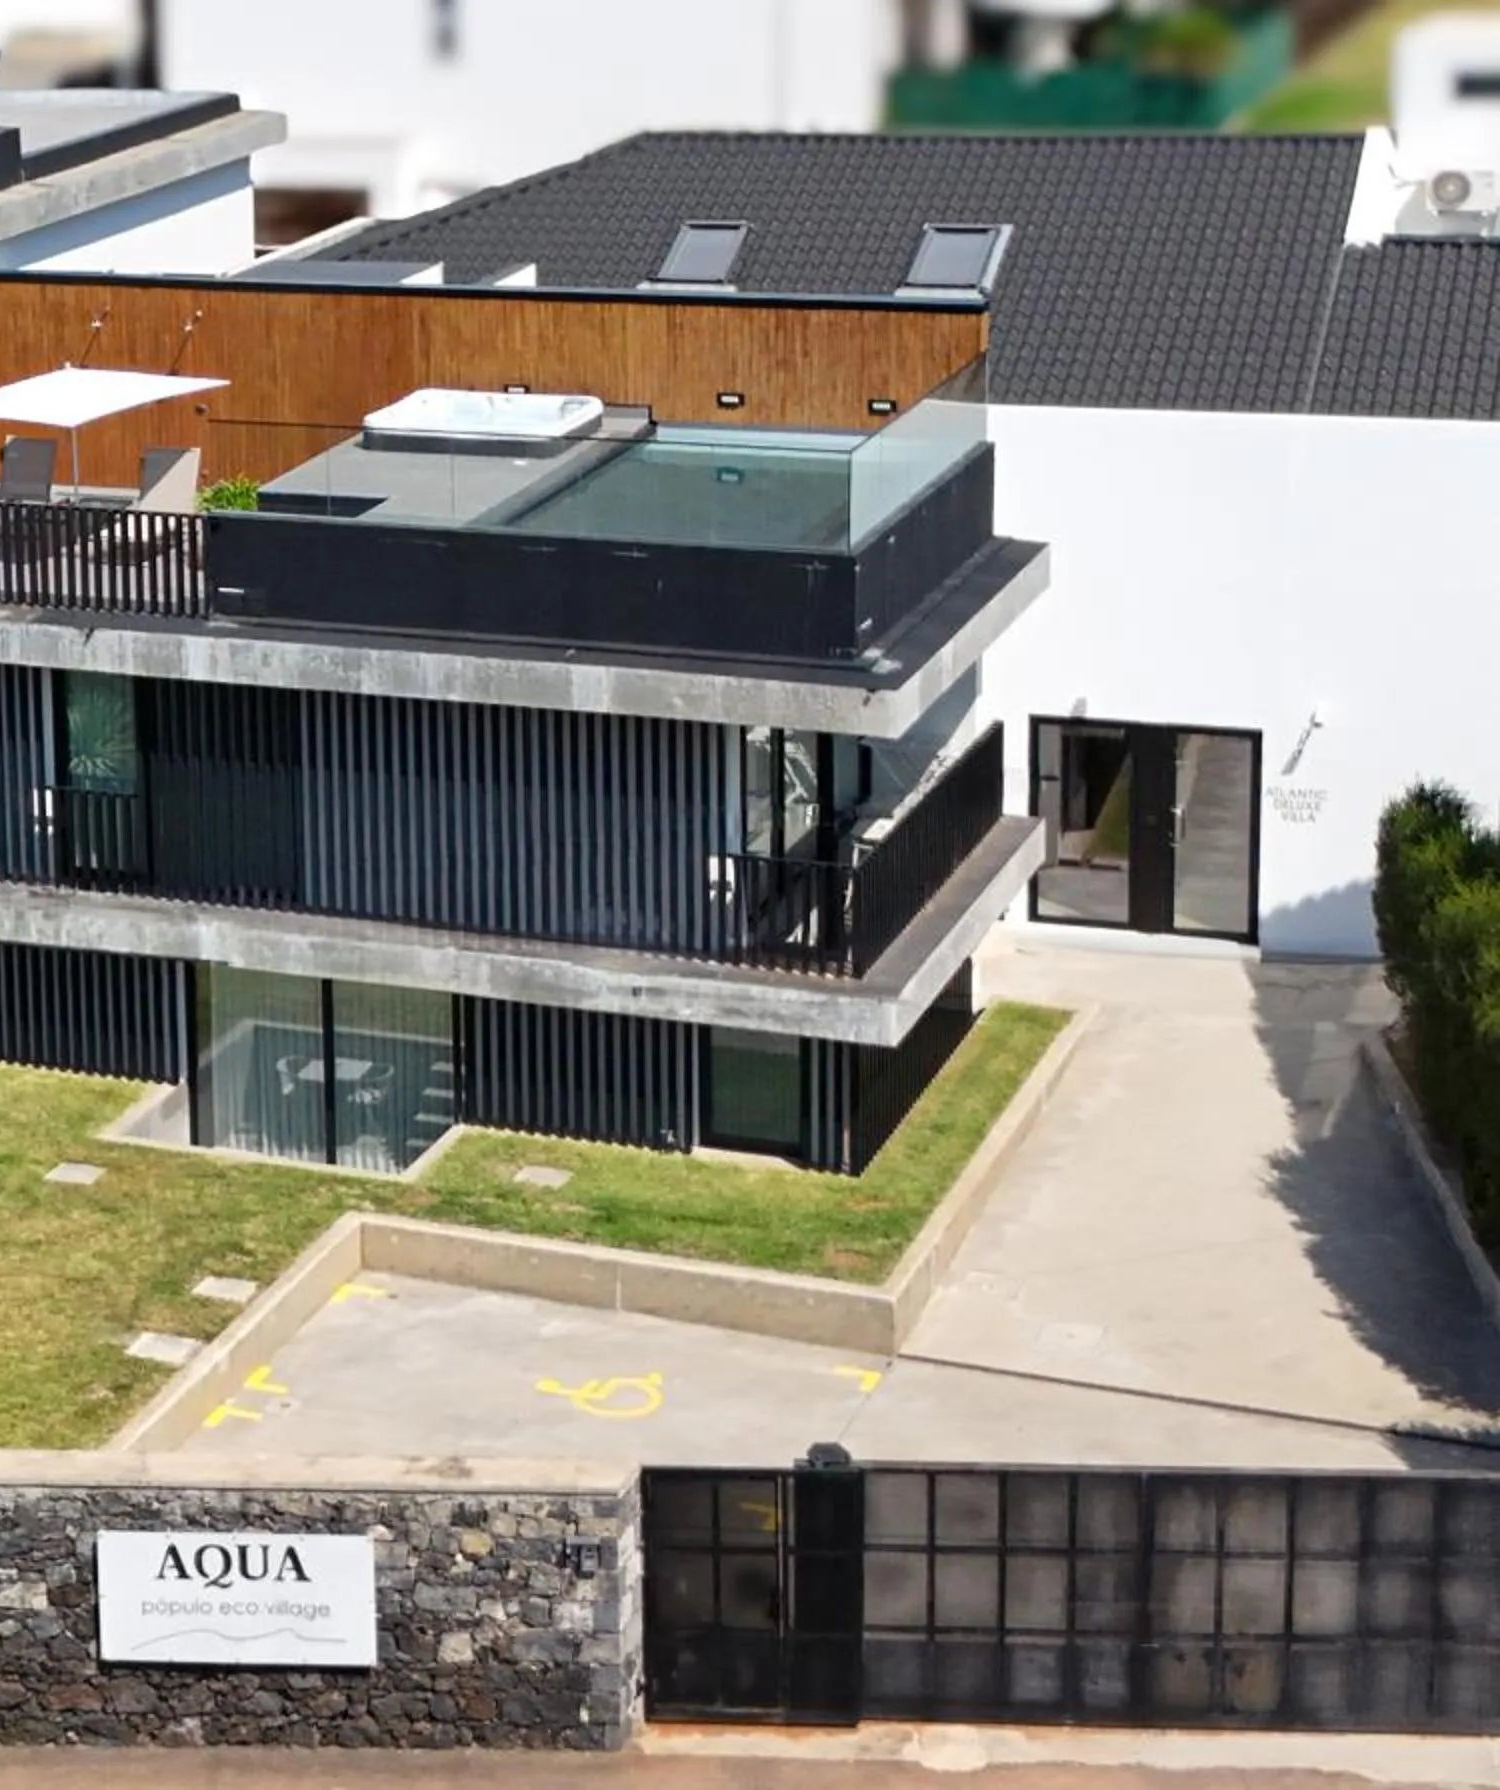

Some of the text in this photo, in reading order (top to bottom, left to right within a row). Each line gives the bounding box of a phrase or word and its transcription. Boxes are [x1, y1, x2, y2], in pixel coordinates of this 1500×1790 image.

[155, 1542, 312, 1589] AQUA
[219, 1600, 259, 1616] eco
[264, 1599, 331, 1622] village
